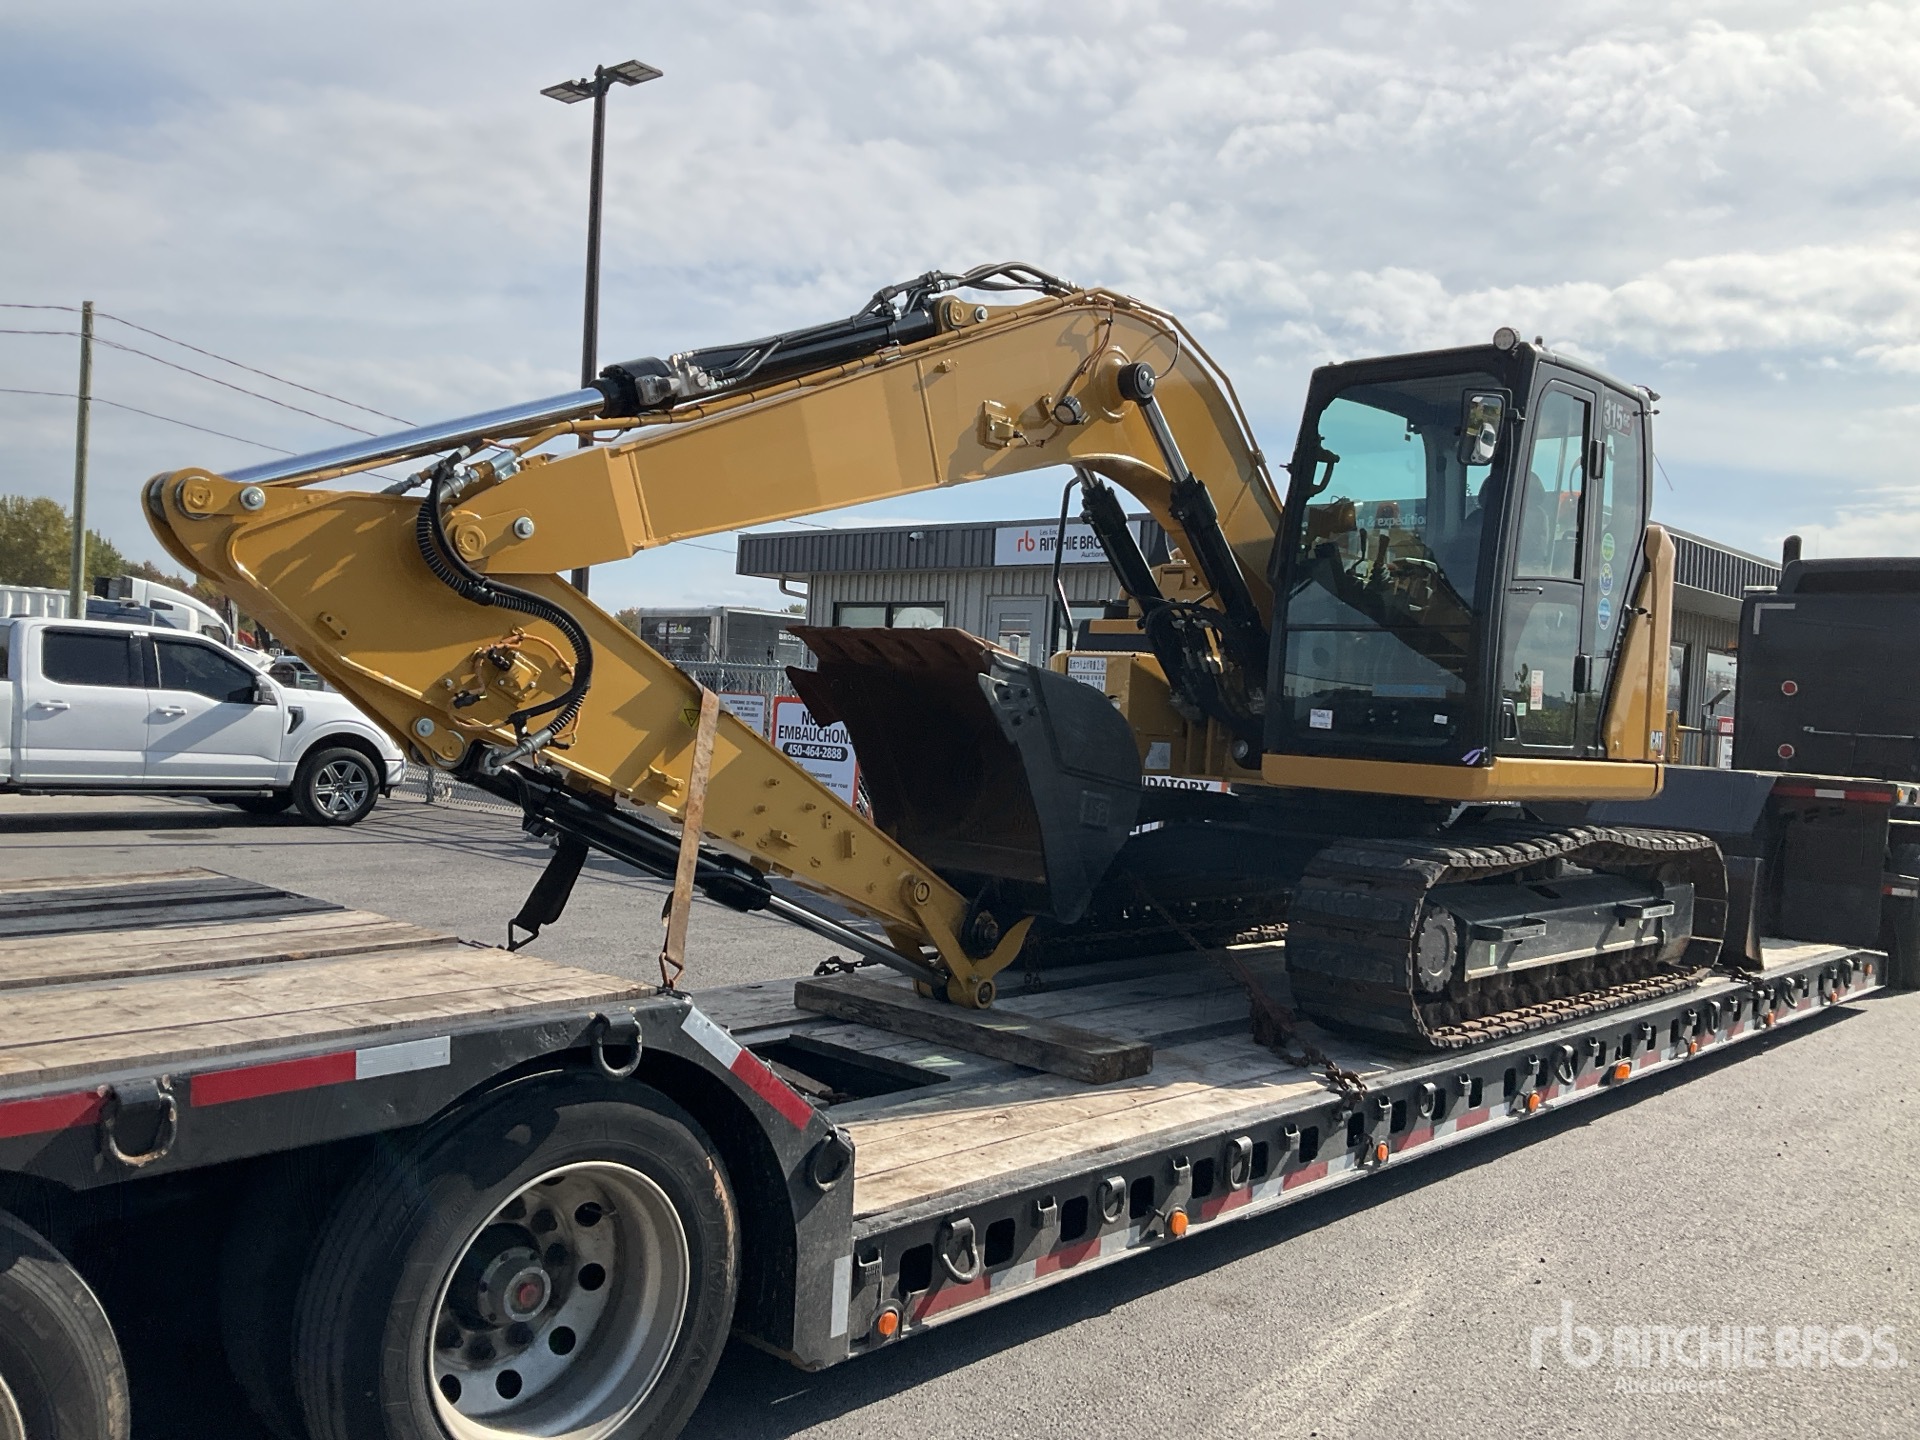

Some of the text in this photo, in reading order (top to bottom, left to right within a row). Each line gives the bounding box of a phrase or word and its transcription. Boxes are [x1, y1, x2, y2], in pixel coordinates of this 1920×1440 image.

[1603, 399, 1623, 430] 315
[1040, 535, 1102, 551] RITHIE BRO
[801, 711, 817, 726] NO
[778, 725, 852, 745] EMBAUCHON
[1650, 730, 1663, 751] CAT
[787, 744, 842, 759] 450-464-2888
[1143, 776, 1210, 791] DATORY
